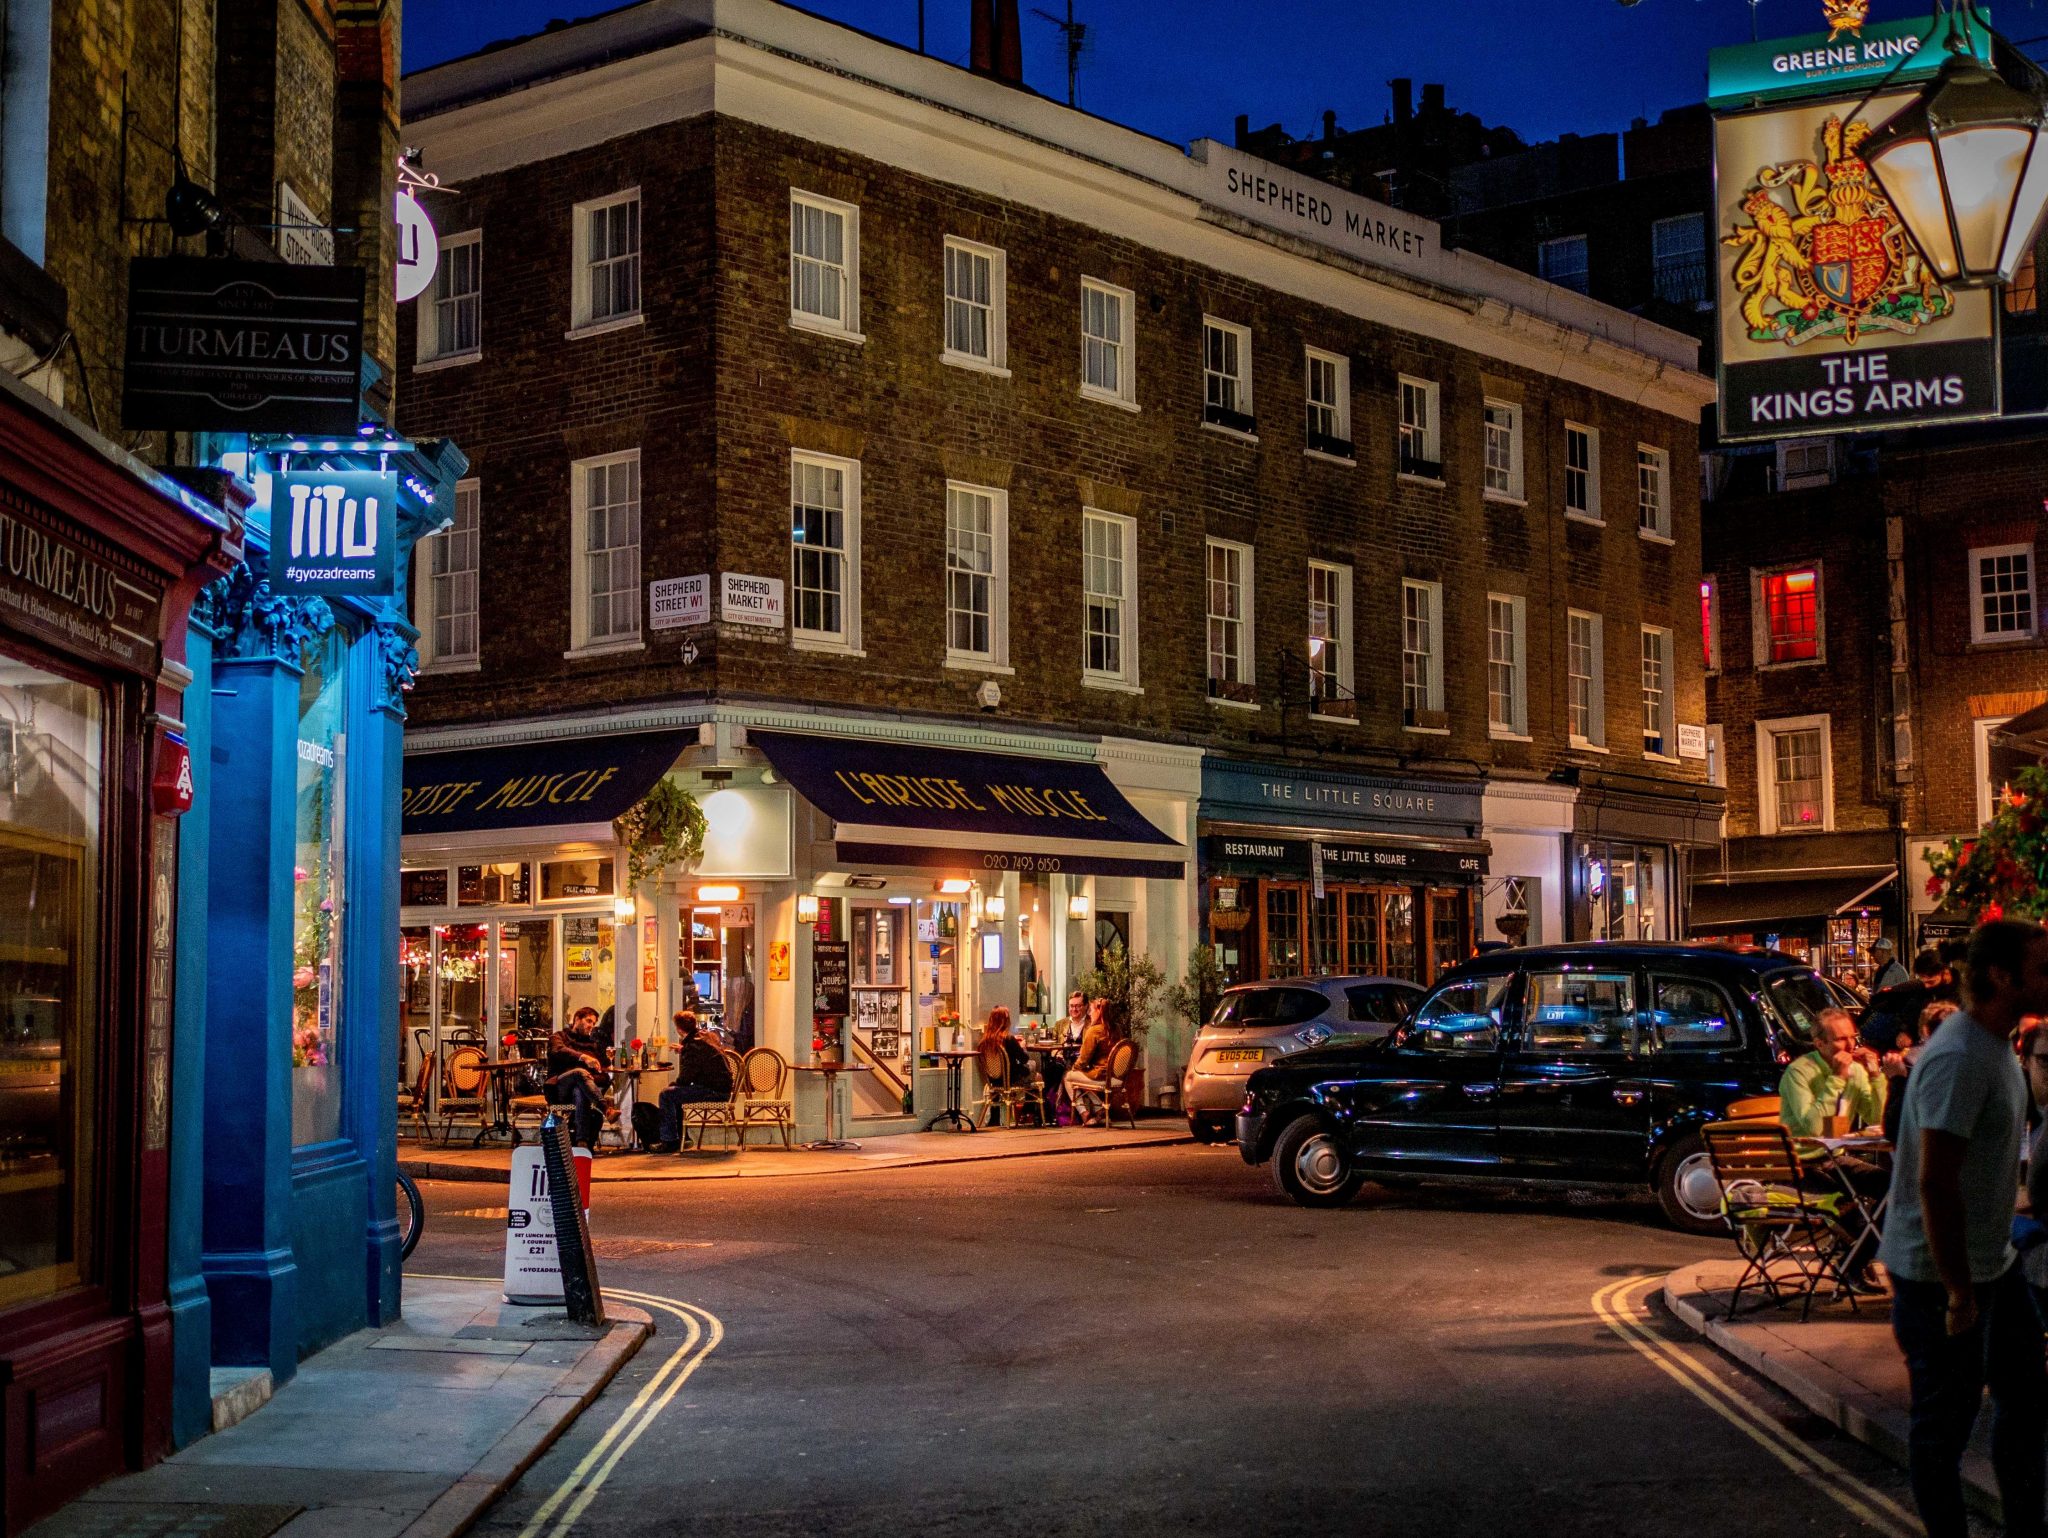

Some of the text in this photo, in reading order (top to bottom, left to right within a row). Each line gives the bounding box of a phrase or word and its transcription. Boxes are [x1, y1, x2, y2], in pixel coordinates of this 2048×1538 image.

[1773, 35, 1921, 73] GREENE KING
[1806, 60, 1886, 78] BURY ST EDMUNDS
[1228, 168, 1424, 258] SHEPHERD MARKET
[288, 197, 331, 264] WHITE HORSE
[133, 325, 350, 363] TURMEAUS
[1821, 354, 1888, 385] THE
[309, 375, 354, 384] SPLENDID
[1751, 376, 1964, 422] KINGS ARMS
[287, 566, 375, 581] #gyozadreams
[655, 580, 702, 598] SHEPHERD
[728, 578, 770, 595] SHEPHERD
[0, 584, 21, 609] rchant
[655, 595, 703, 612] STREET W1
[728, 593, 779, 611] MARKET W1
[671, 614, 700, 624] WESTMINSTER
[744, 614, 772, 624] WESTMINSTER
[297, 738, 334, 769] ozadreams
[475, 767, 619, 811] MUSCLE
[834, 770, 1107, 820] L'ARTISTE MUSCLE
[1261, 783, 1435, 812] THE LITTLE SQUARE
[1225, 843, 1285, 858] RESTAURANT
[1322, 848, 1407, 866] THE LITTLE SQUARE
[984, 854, 1060, 872] 020 7493 6150
[1460, 857, 1479, 870] CAFE
[529, 1247, 545, 1255] £21
